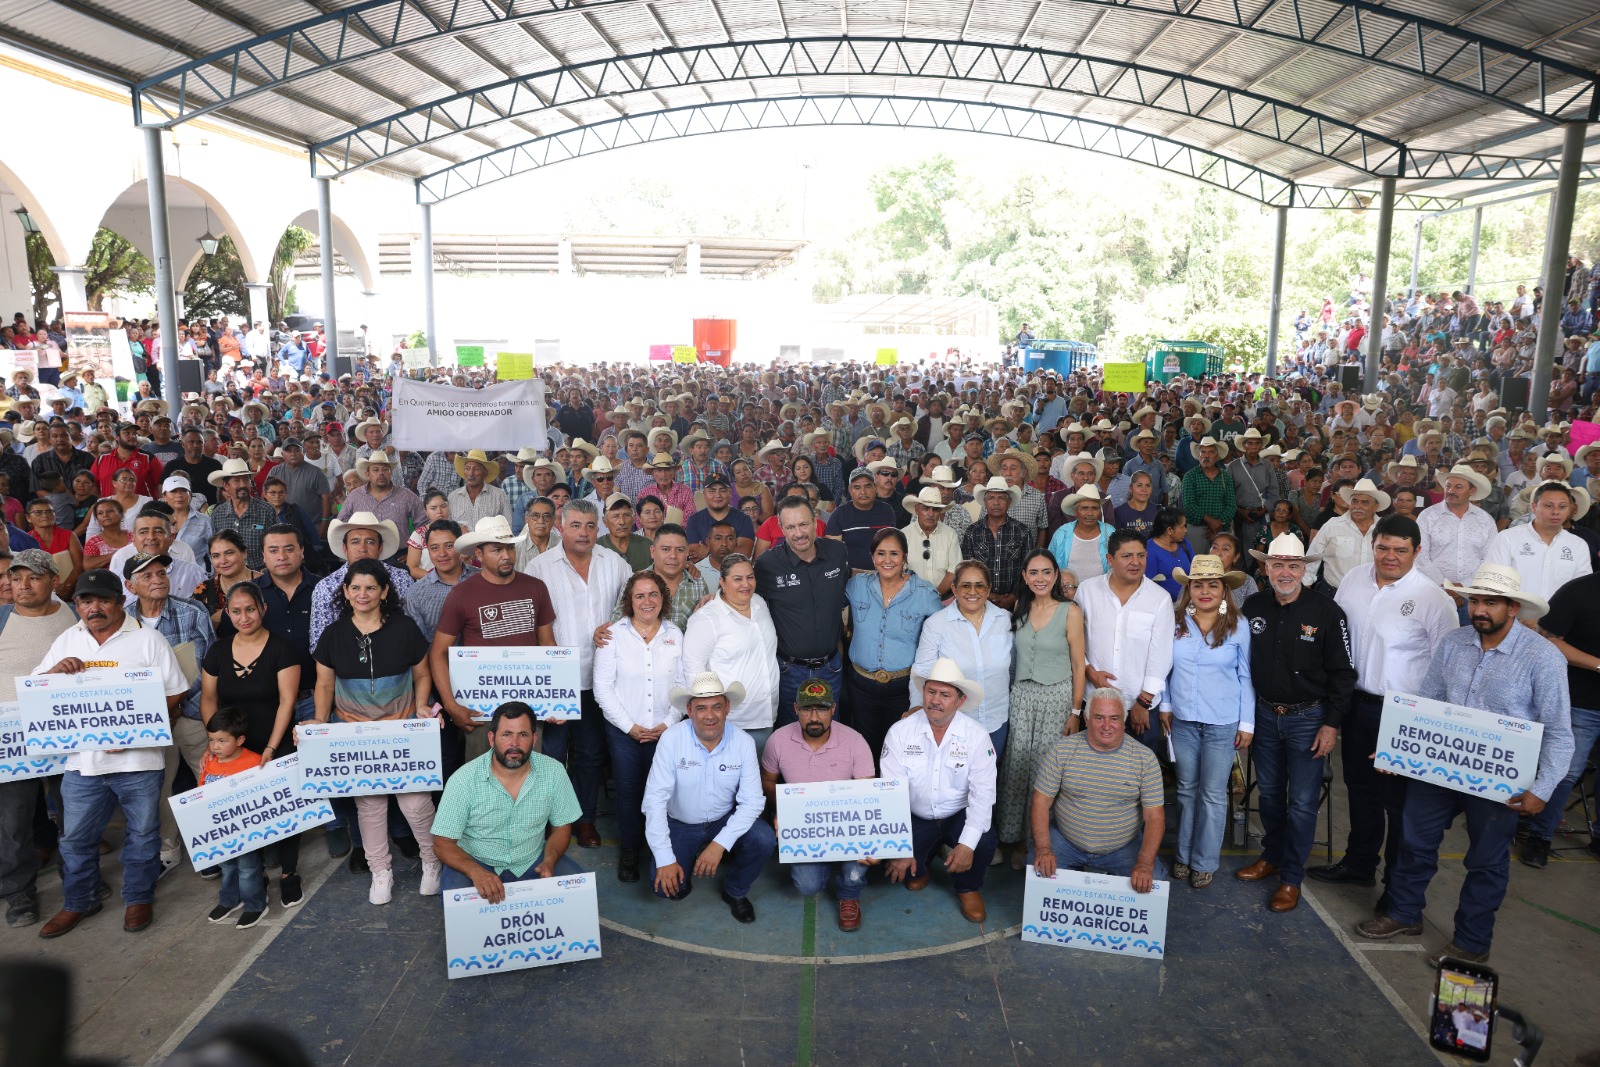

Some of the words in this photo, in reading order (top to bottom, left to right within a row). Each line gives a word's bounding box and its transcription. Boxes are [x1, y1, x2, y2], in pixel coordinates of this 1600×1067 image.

[398, 398, 409, 406] En
[410, 398, 446, 408] Querétaro
[447, 400, 459, 408] los
[460, 400, 498, 410] ganaderos
[426, 408, 455, 417] AMIGO
[456, 408, 513, 417] GOBERNADOR
[1219, 429, 1238, 441] Lee
[478, 675, 532, 686] SEMILLA
[535, 675, 551, 685] DE
[50, 691, 78, 700] APOYO
[79, 690, 113, 698] ESTATAL
[454, 689, 498, 699] AVENA
[501, 688, 577, 699] FORRAJERA
[52, 701, 113, 716] SEMILLA
[116, 699, 135, 712] DE
[28, 719, 77, 732] AVENA
[81, 712, 163, 728] FORRAJERA
[1413, 716, 1441, 728] APOYO
[1443, 722, 1479, 737] ESTATAL
[1481, 731, 1502, 742] CON
[358, 738, 391, 746] ESTATAL
[1398, 724, 1487, 756] REMOLQUE
[1491, 747, 1515, 763] DE
[329, 750, 388, 763] SEMILLA
[393, 748, 411, 759] DE
[1391, 737, 1421, 755] USO
[1425, 746, 1519, 780] GANADERO
[305, 765, 350, 777] PASTO
[354, 760, 436, 774] FORRAJERO
[207, 795, 235, 810] APOYO
[235, 783, 269, 799] ESTATAL
[270, 776, 288, 787] CON
[211, 796, 272, 825] SEMILLA
[272, 787, 293, 802] DE
[191, 820, 244, 848] AVENA
[241, 797, 324, 829] FORRAJER
[804, 810, 861, 824] SISTEMA
[864, 808, 882, 820] DE
[781, 826, 845, 840] COSECHA
[848, 824, 866, 836] DE
[869, 822, 909, 836] AGUA
[1055, 888, 1083, 897] APOYO
[1084, 892, 1117, 901] ESTATAL
[1118, 895, 1136, 903] CON
[479, 904, 507, 914] APOYO
[509, 900, 544, 910] ESTATAL
[546, 897, 565, 905] CON
[1043, 897, 1124, 917] REMOLQUE
[1129, 908, 1149, 921] DE
[501, 911, 545, 930] DRÓN
[1040, 911, 1069, 924] USO
[1072, 915, 1149, 935] AGRÍCOLA
[483, 926, 565, 948] AGRÍCOLA
